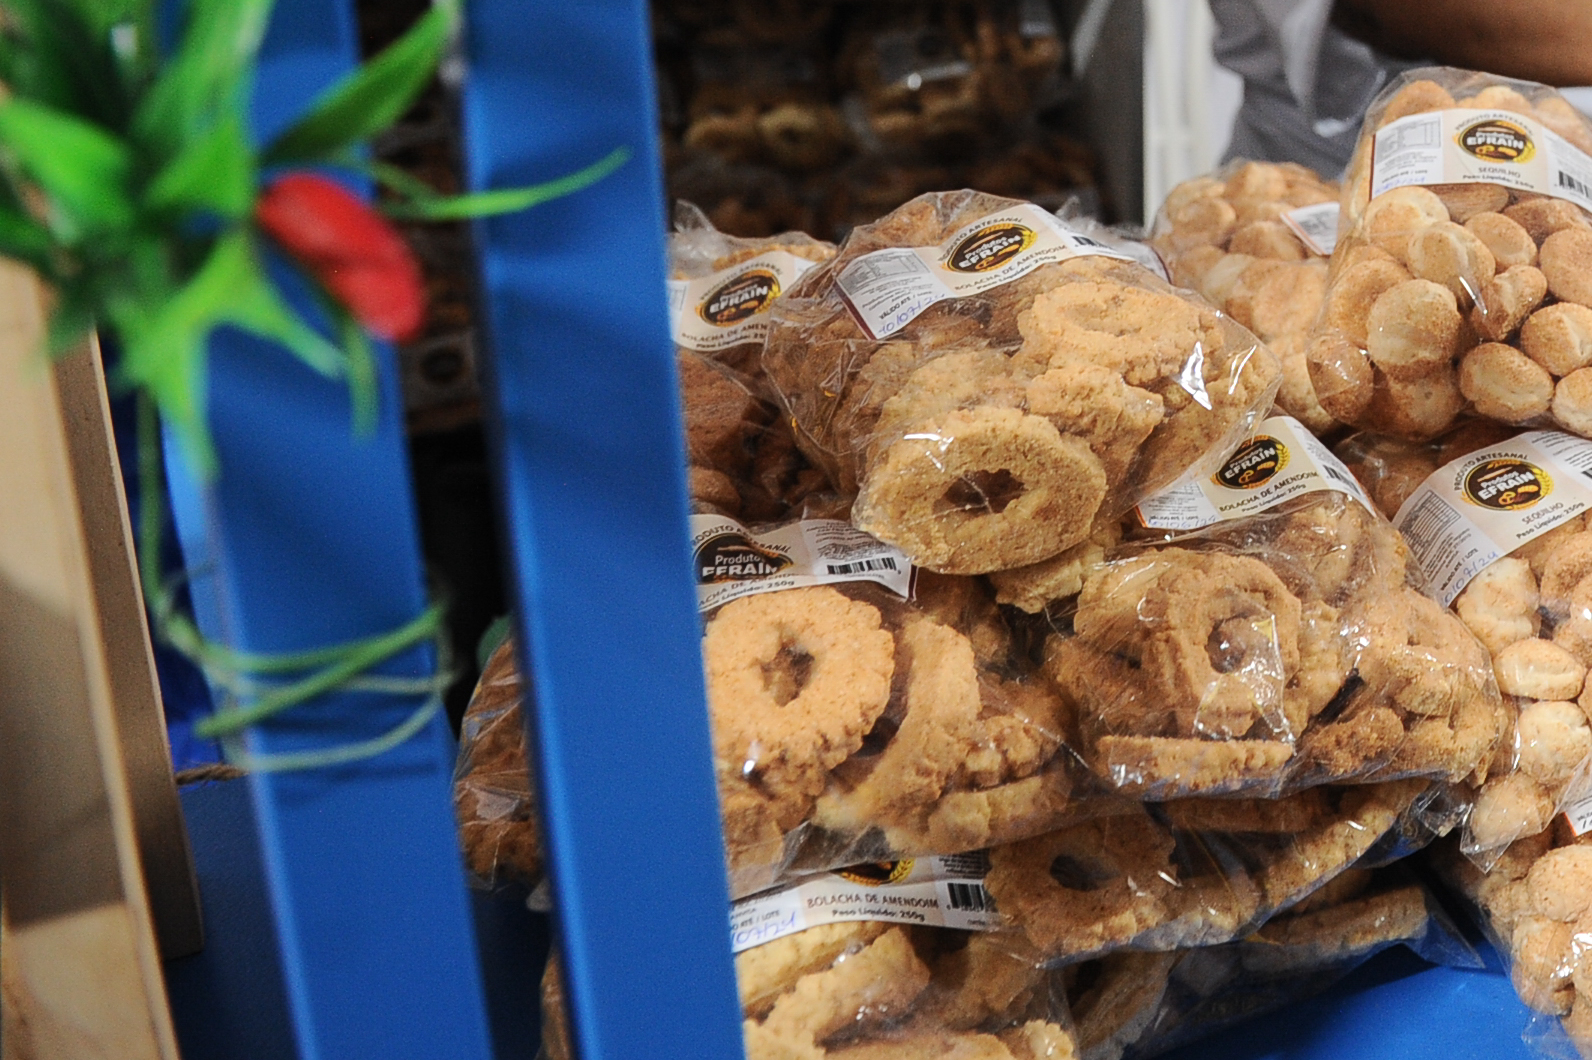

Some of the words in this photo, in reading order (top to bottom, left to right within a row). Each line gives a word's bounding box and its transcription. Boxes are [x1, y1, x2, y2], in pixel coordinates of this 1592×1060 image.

[1466, 136, 1524, 149] EFRAIN
[1478, 166, 1521, 179] SEQUILHO
[959, 235, 1022, 268] EFRAIN
[1002, 265, 1015, 275] DE
[1017, 244, 1067, 266] AMENDOIM
[710, 285, 769, 314] EFRAIN
[742, 323, 768, 332] AMEN
[1224, 447, 1276, 479] EFRAIN
[1454, 459, 1476, 491] PRODUTO
[1475, 452, 1528, 462] ARTESANAL
[1218, 495, 1260, 512] BOLACHA
[1260, 488, 1273, 498] DE
[1274, 471, 1319, 492] AMENDOIM
[1478, 471, 1536, 500] EFRAIN
[1521, 502, 1564, 525] SEQUILHO
[767, 580, 795, 589] 250g
[807, 892, 862, 908] BOLACHA
[865, 893, 880, 904] DE
[882, 895, 939, 909] AMENDOIM
